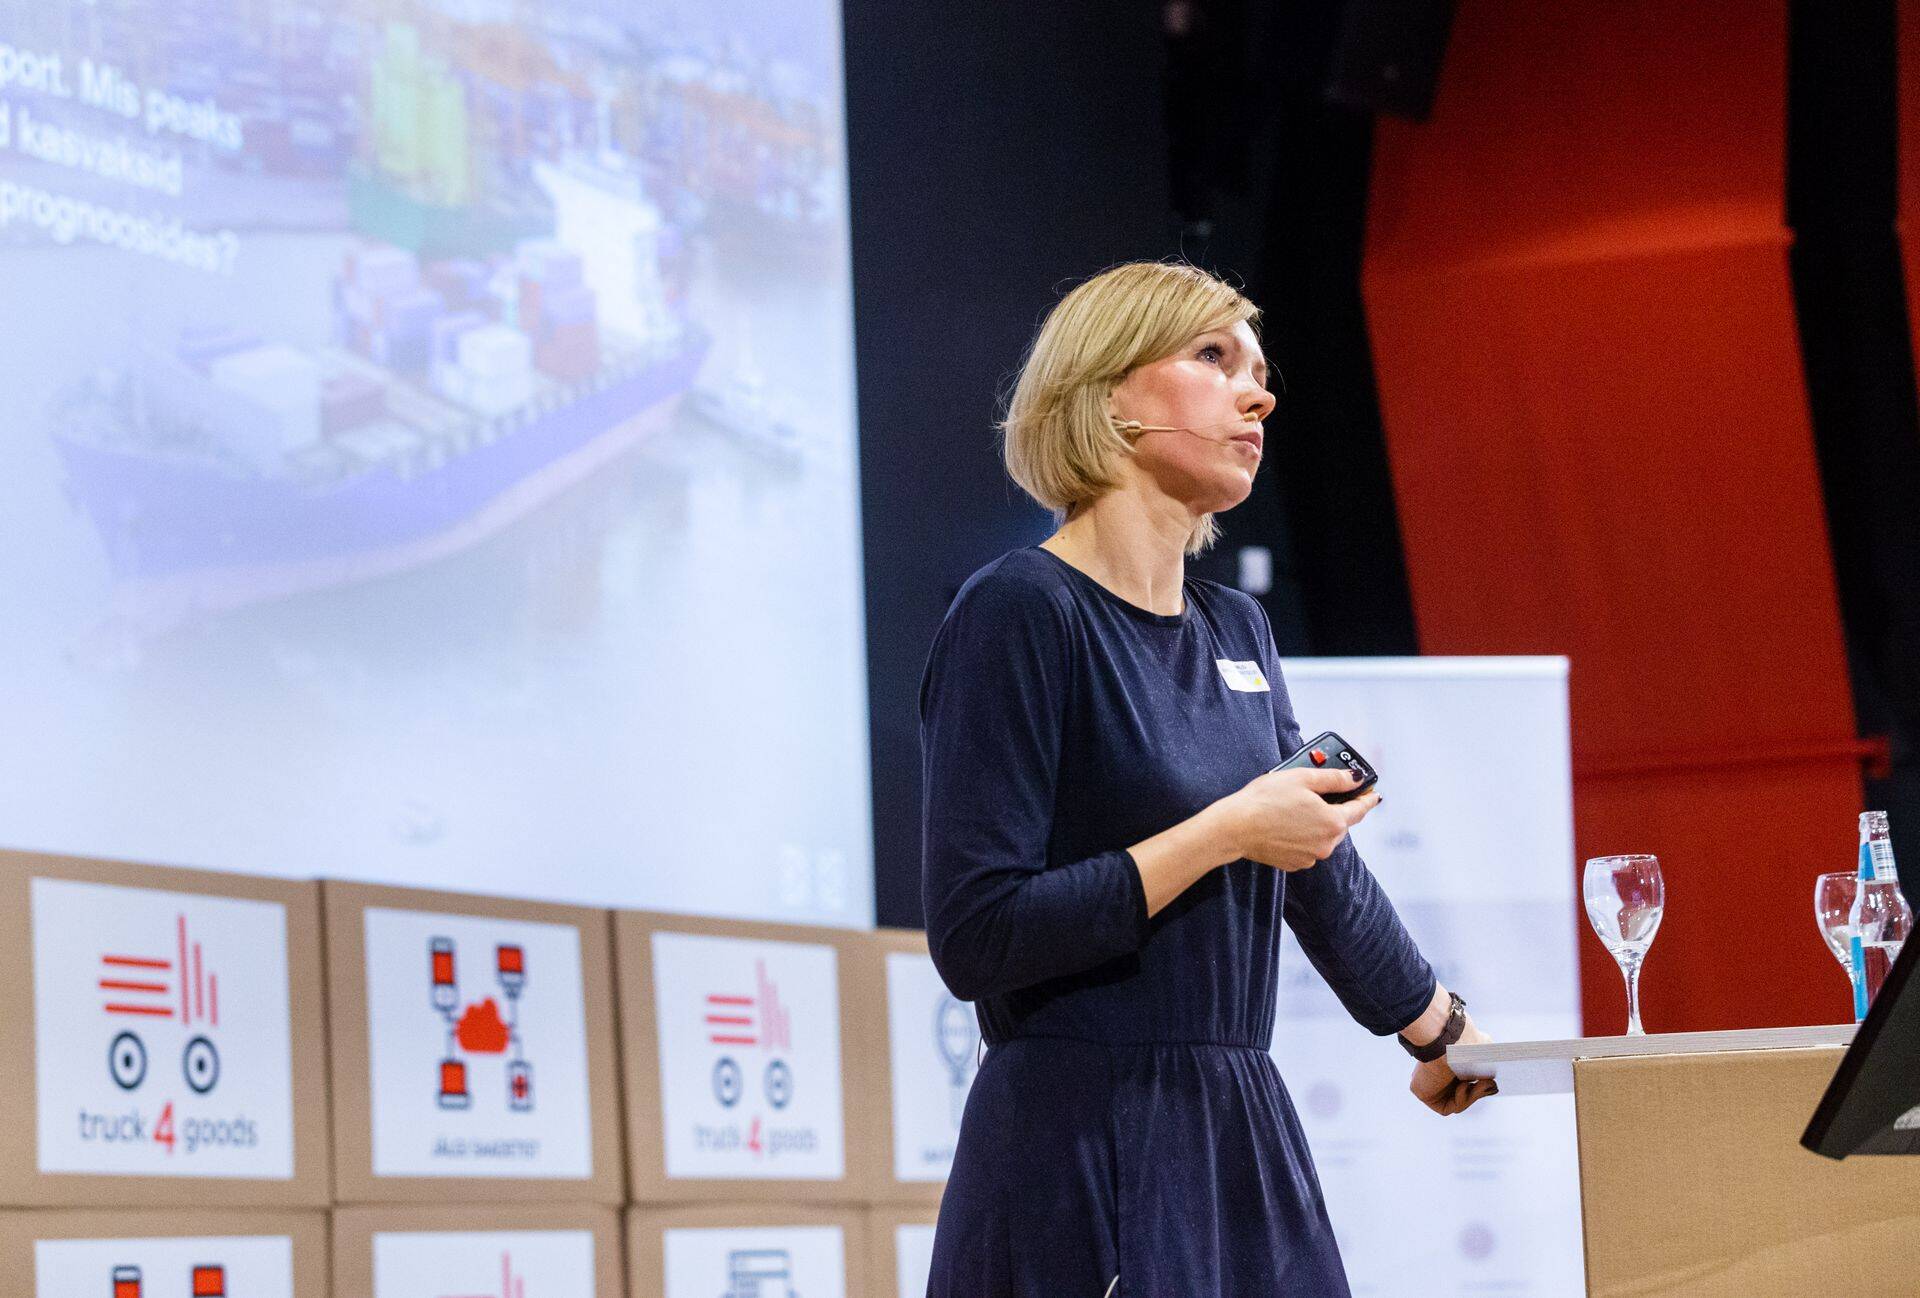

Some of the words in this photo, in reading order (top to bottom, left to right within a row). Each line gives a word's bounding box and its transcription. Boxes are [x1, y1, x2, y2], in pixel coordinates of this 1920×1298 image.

[18, 103, 183, 197] kasvaksid
[79, 55, 140, 119] Mis
[145, 88, 244, 151] peaks
[78, 1108, 147, 1144] truck
[153, 1101, 176, 1156] 4
[182, 1114, 258, 1154] goods
